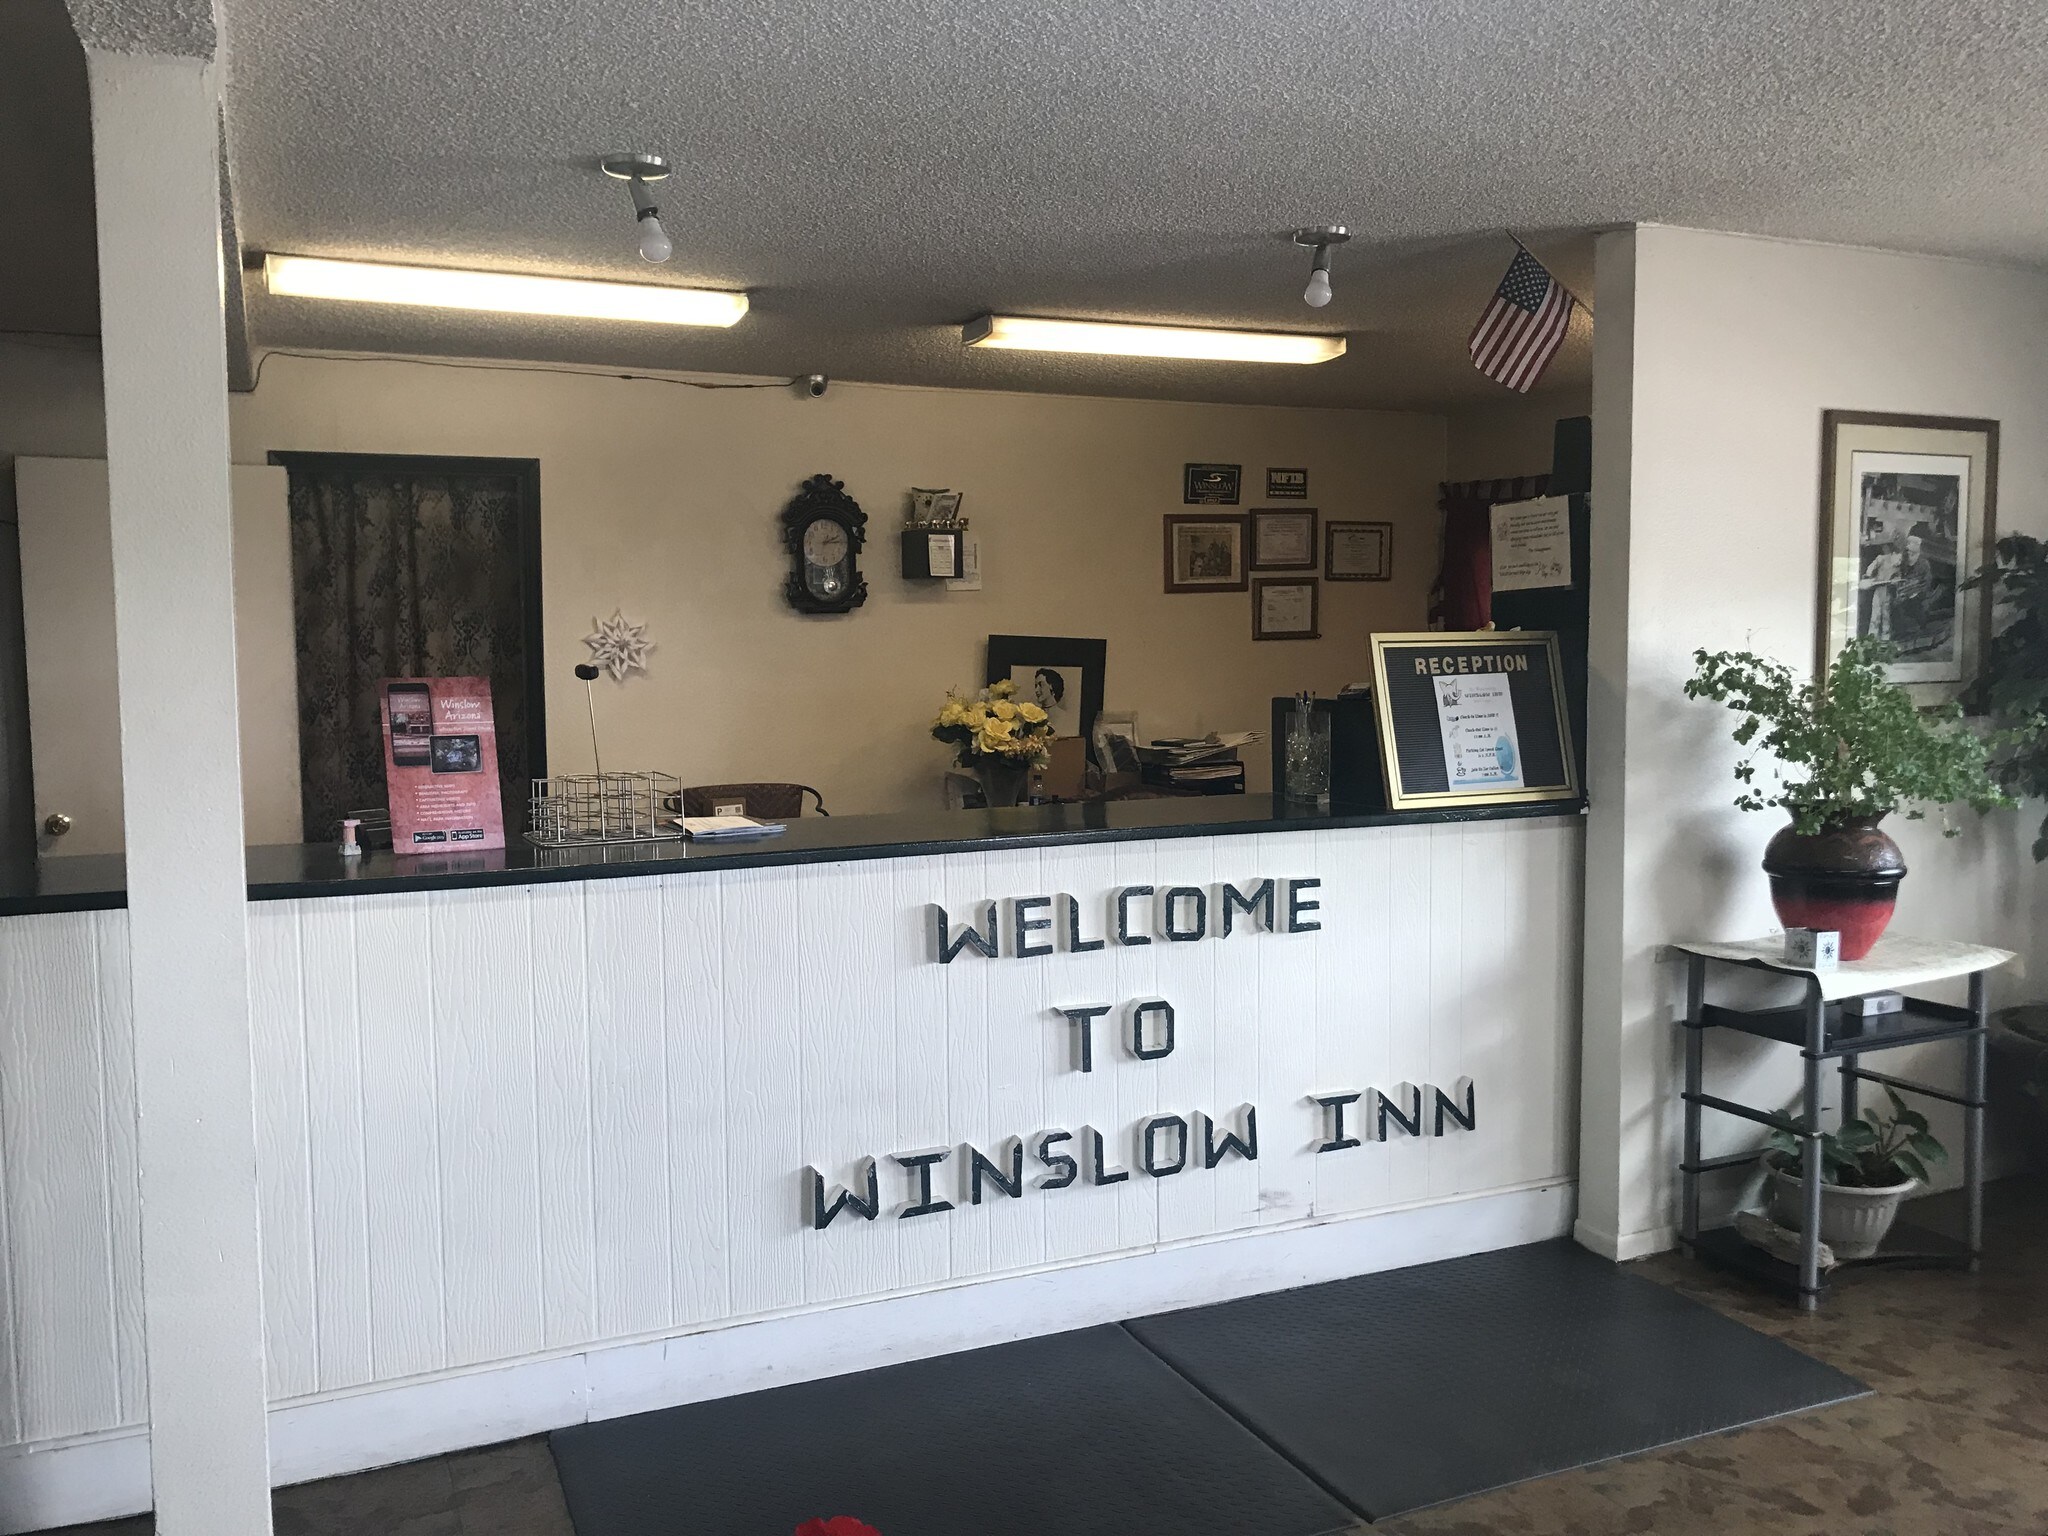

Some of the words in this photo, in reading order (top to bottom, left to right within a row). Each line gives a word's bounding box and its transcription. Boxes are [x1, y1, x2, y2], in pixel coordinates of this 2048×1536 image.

[1192, 481, 1233, 491] WINSLOW
[1414, 654, 1528, 675] RECEPTION
[440, 699, 481, 710] Winslow
[445, 710, 482, 721] Arizona
[931, 877, 1322, 964] WELCOME
[1056, 996, 1175, 1073] TO
[808, 1103, 1258, 1230] WINSLOW
[1307, 1076, 1476, 1153] INN
